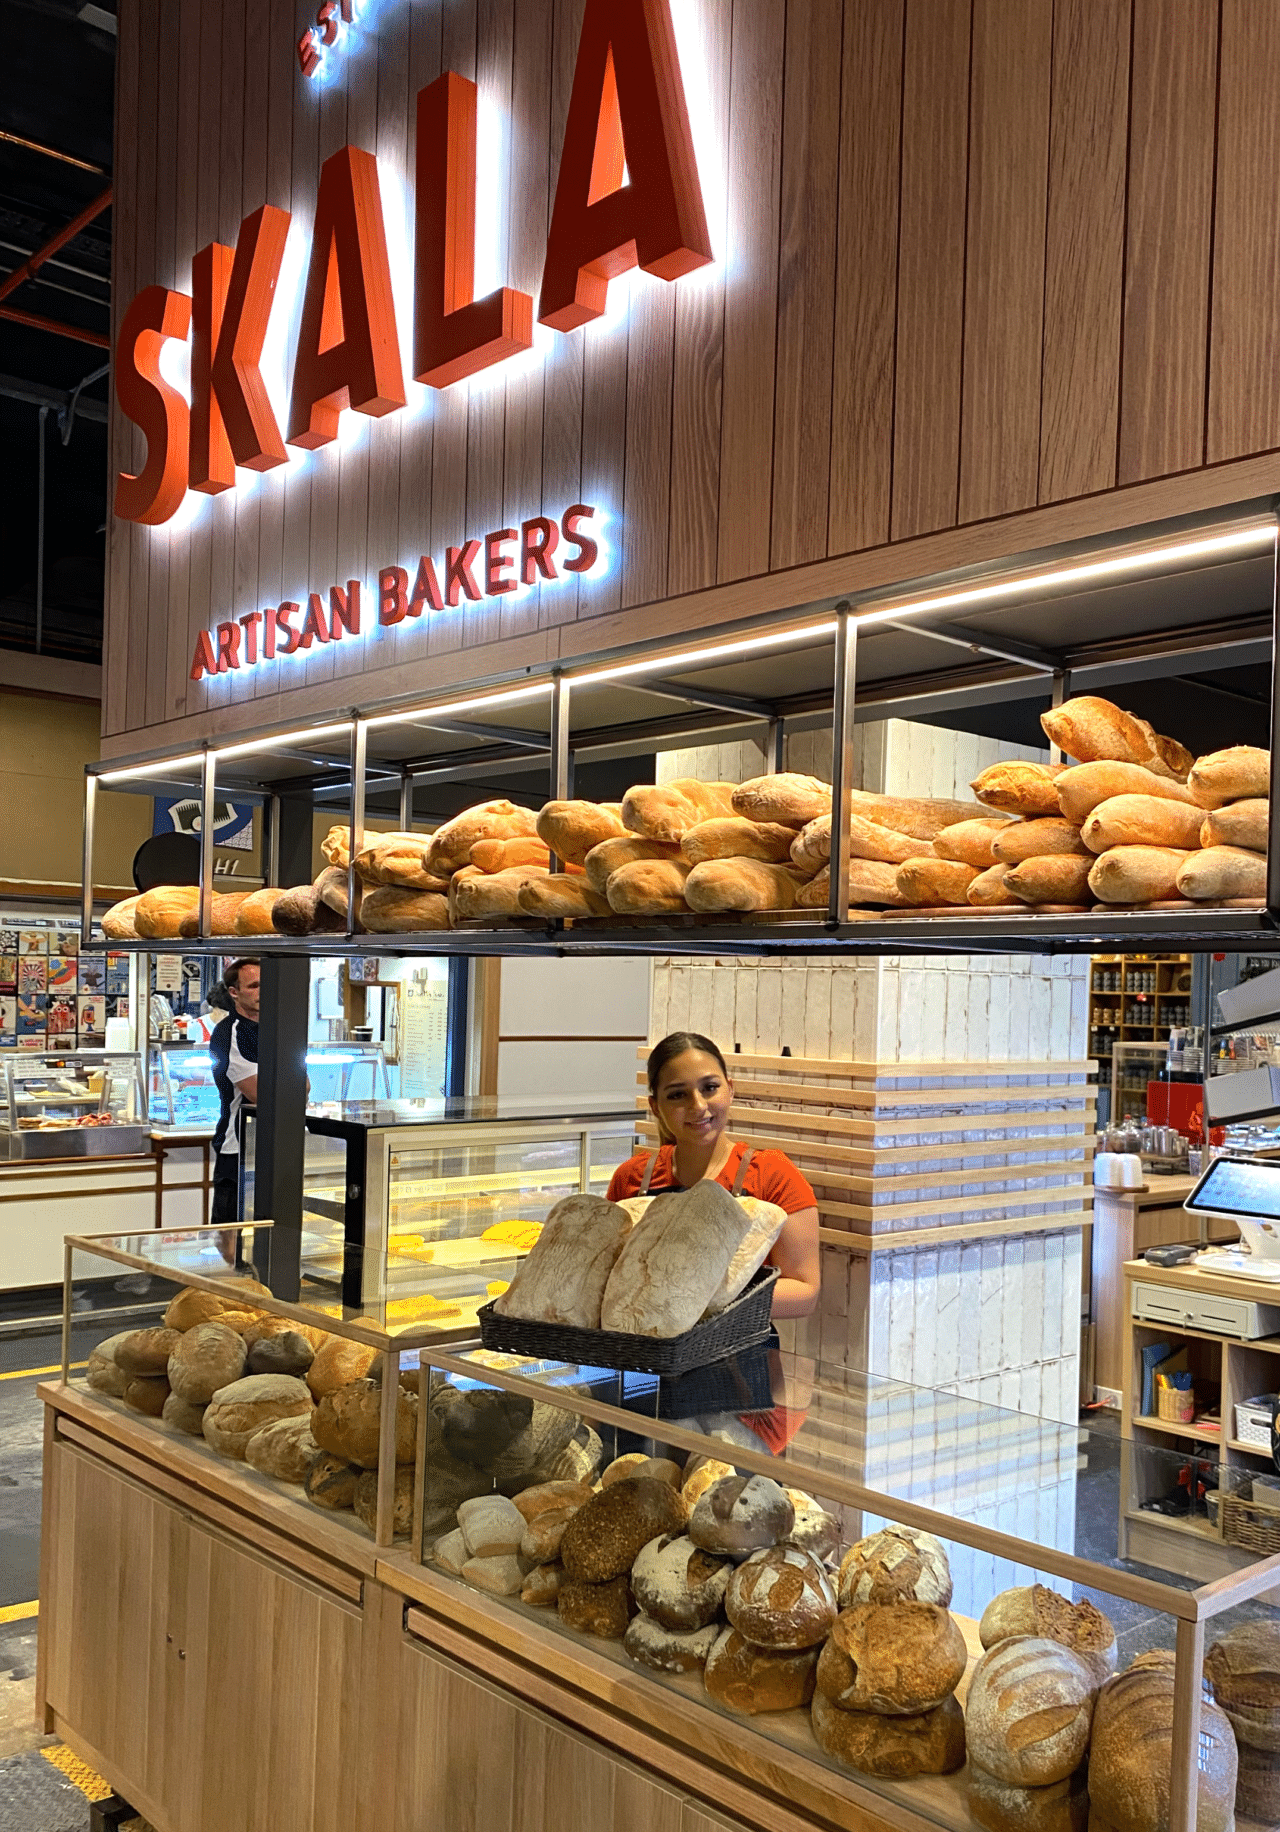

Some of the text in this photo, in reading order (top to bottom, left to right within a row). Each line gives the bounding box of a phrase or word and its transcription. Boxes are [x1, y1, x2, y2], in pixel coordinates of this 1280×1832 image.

[113, 0, 714, 526] SKALA
[190, 504, 599, 681] ARTISAN BAKERS
